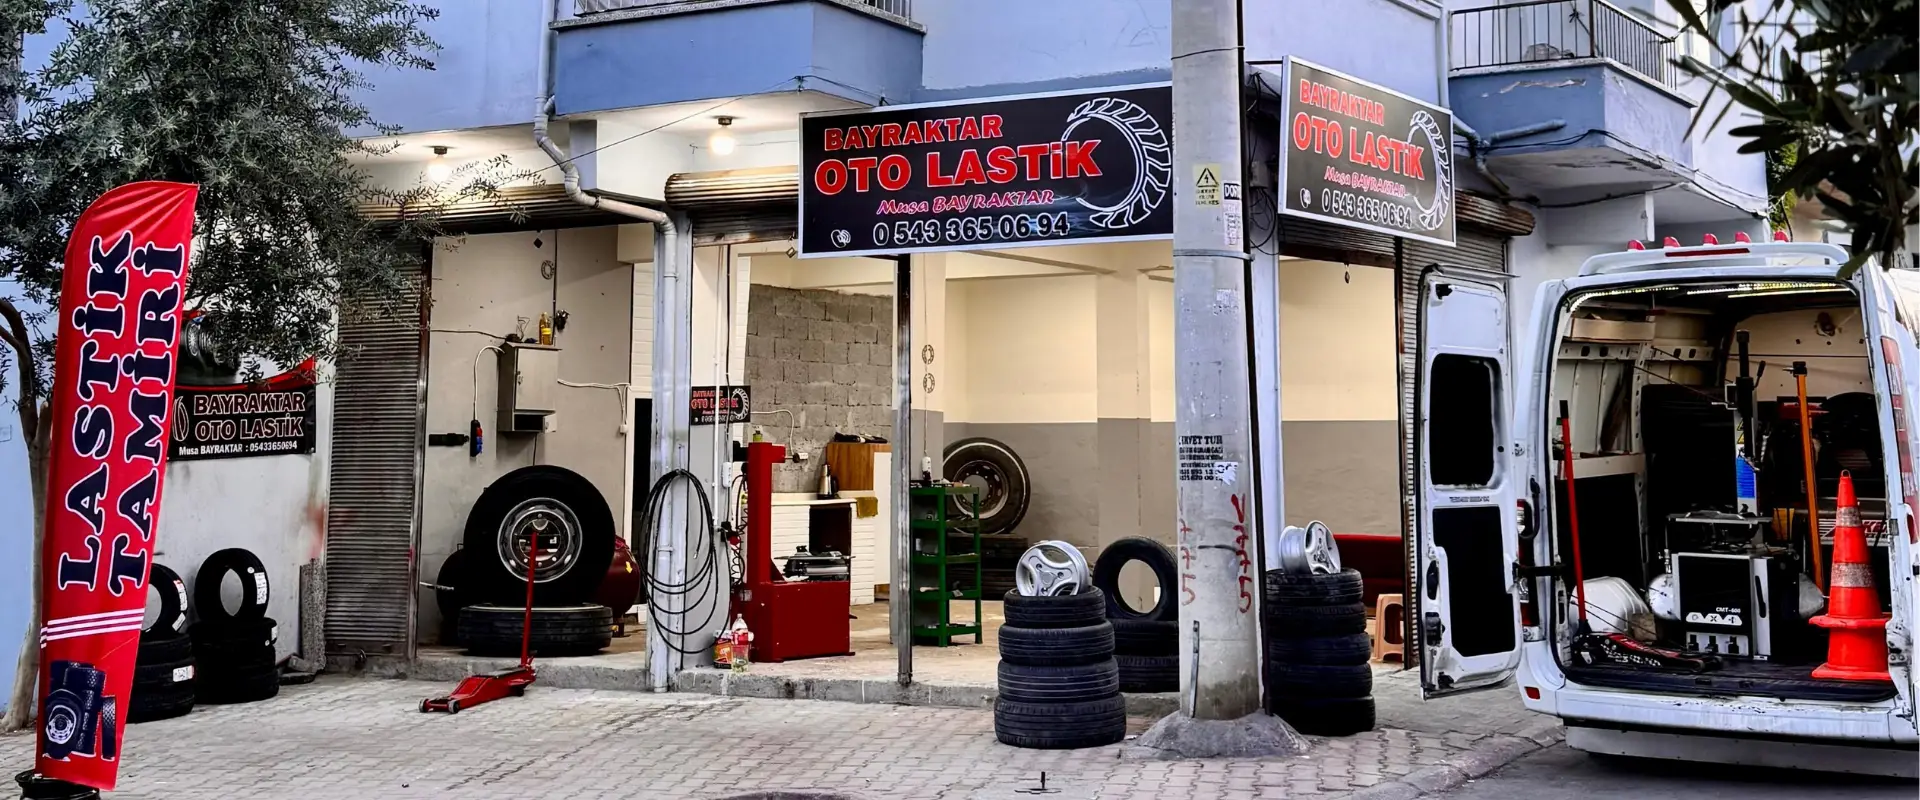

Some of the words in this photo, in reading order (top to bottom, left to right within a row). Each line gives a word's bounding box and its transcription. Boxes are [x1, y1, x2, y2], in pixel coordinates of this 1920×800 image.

[1300, 79, 1385, 126] BAYRAKTAR
[824, 114, 1003, 151] BAYRAKTAR
[1293, 111, 1343, 159] OTO
[814, 154, 911, 195] OTO
[1323, 165, 1351, 186] Musa
[1351, 172, 1407, 199] BAYRAKTAR
[876, 199, 929, 215] Musa
[932, 189, 1055, 213] BAYRAKTAR
[1322, 188, 1331, 213] 0
[1332, 190, 1356, 218] 543
[1357, 195, 1380, 222] 365
[1381, 201, 1396, 226] 06
[1398, 205, 1412, 230] 94
[873, 222, 889, 246] 0
[894, 219, 941, 244] 543
[945, 215, 993, 242] 365
[998, 213, 1031, 239] 06
[1036, 211, 1070, 237] 94
[58, 229, 133, 592] LASTİK
[108, 241, 184, 597] TAMİRİ
[193, 391, 306, 415] BAYRAKTAR
[691, 398, 708, 409] OTO
[195, 420, 236, 441] OTO
[240, 413, 304, 439] LASTİK
[179, 446, 199, 456] Musa
[200, 443, 243, 455] BAYRAKTAR
[249, 440, 298, 452] 05433650694
